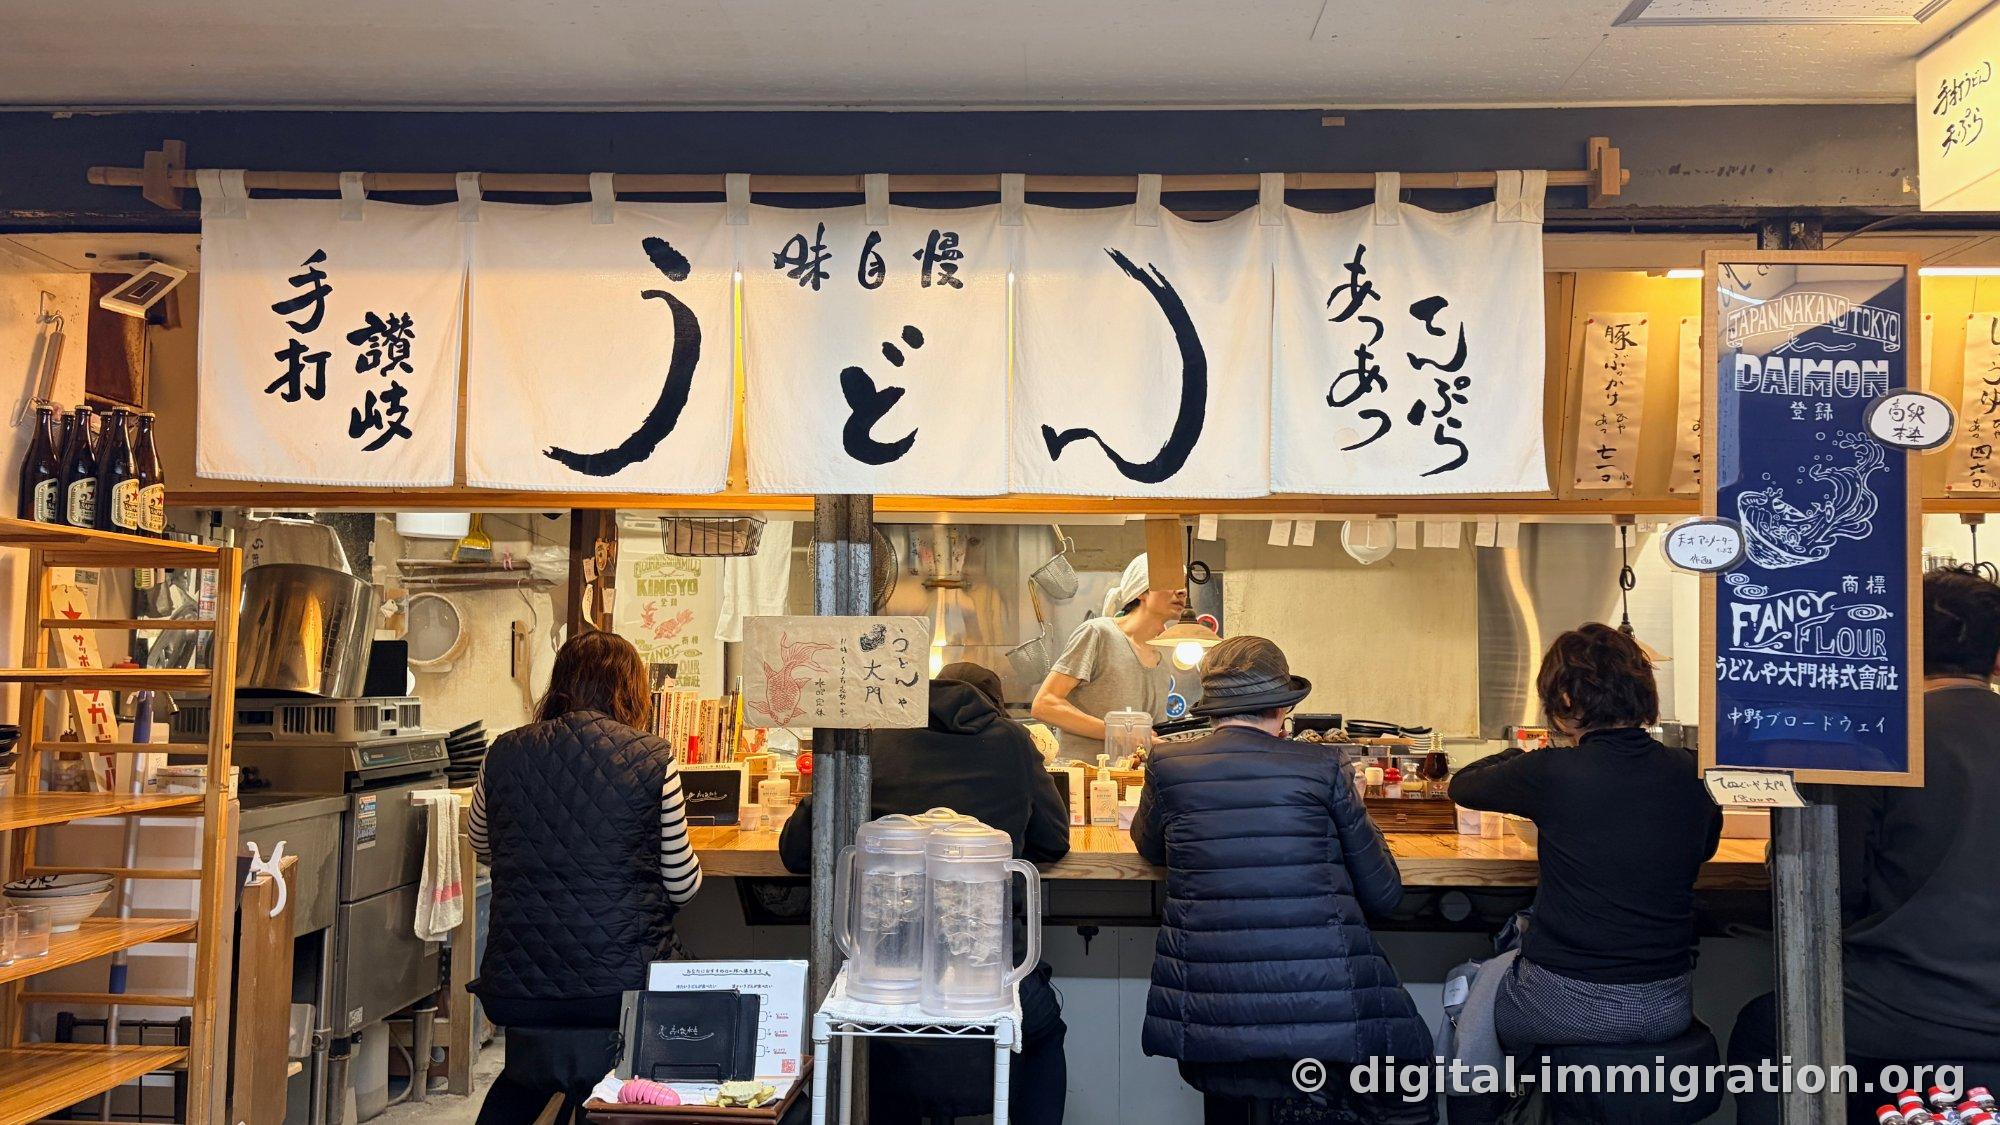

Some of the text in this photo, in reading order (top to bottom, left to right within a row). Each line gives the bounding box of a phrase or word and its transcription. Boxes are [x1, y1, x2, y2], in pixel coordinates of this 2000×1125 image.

[1933, 61, 1991, 116] 手打うどん
[1941, 107, 1983, 158] 天ぷら
[774, 222, 963, 290] 味自慢
[264, 249, 332, 402] 手打
[1730, 294, 1896, 341] JAPAN NAKANO TOKYO
[543, 237, 1207, 483] うどん
[1735, 354, 1889, 397] DAIMON
[1407, 296, 1470, 476] てんぷら
[1790, 401, 1834, 421] 登録
[1889, 399, 1925, 424] 高級
[637, 578, 698, 596] KINGYO
[1842, 575, 1886, 595] 商標
[1730, 591, 1837, 647] FANCY
[1795, 612, 1887, 657] FLOUR
[863, 659, 885, 705] 大門
[1727, 707, 1885, 733] 中野ブロードウェイ
